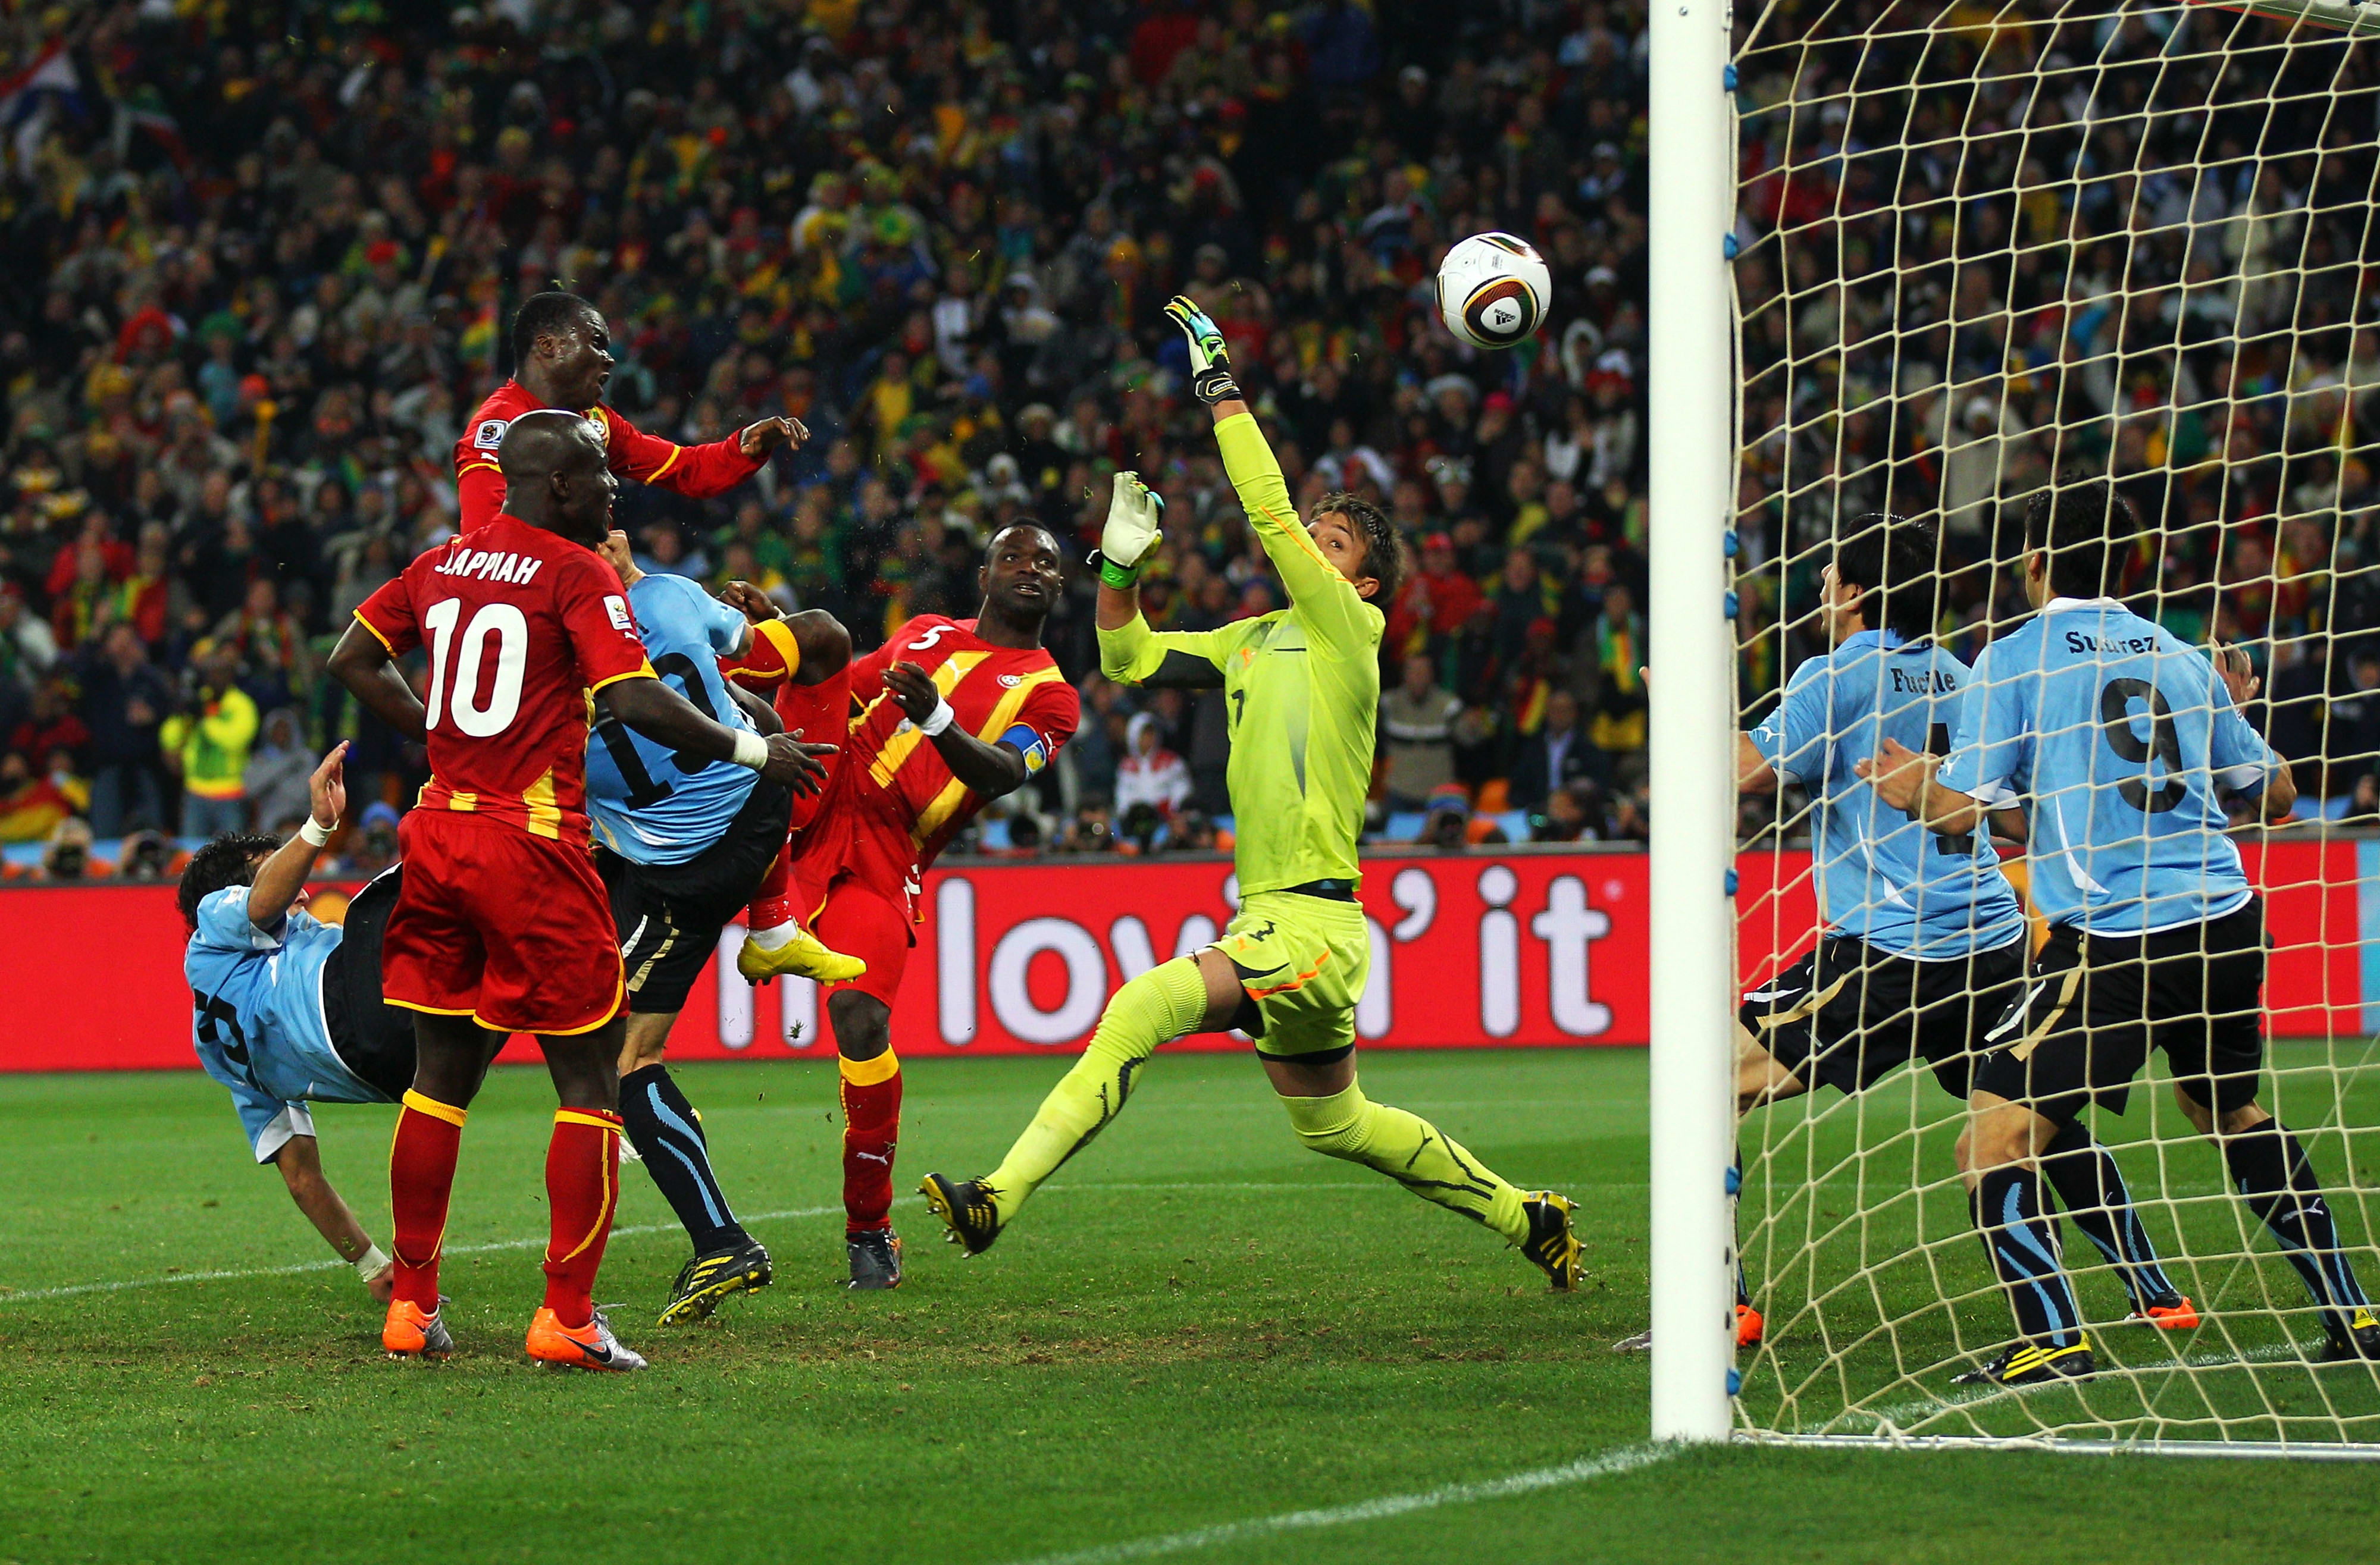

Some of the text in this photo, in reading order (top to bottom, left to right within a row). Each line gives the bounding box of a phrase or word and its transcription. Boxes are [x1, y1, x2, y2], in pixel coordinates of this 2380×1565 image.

[434, 547, 543, 585] J.APPIAH
[425, 597, 528, 738] 10
[907, 625, 956, 651] 5
[2100, 677, 2187, 814] 9
[1478, 865, 1613, 1037] it
